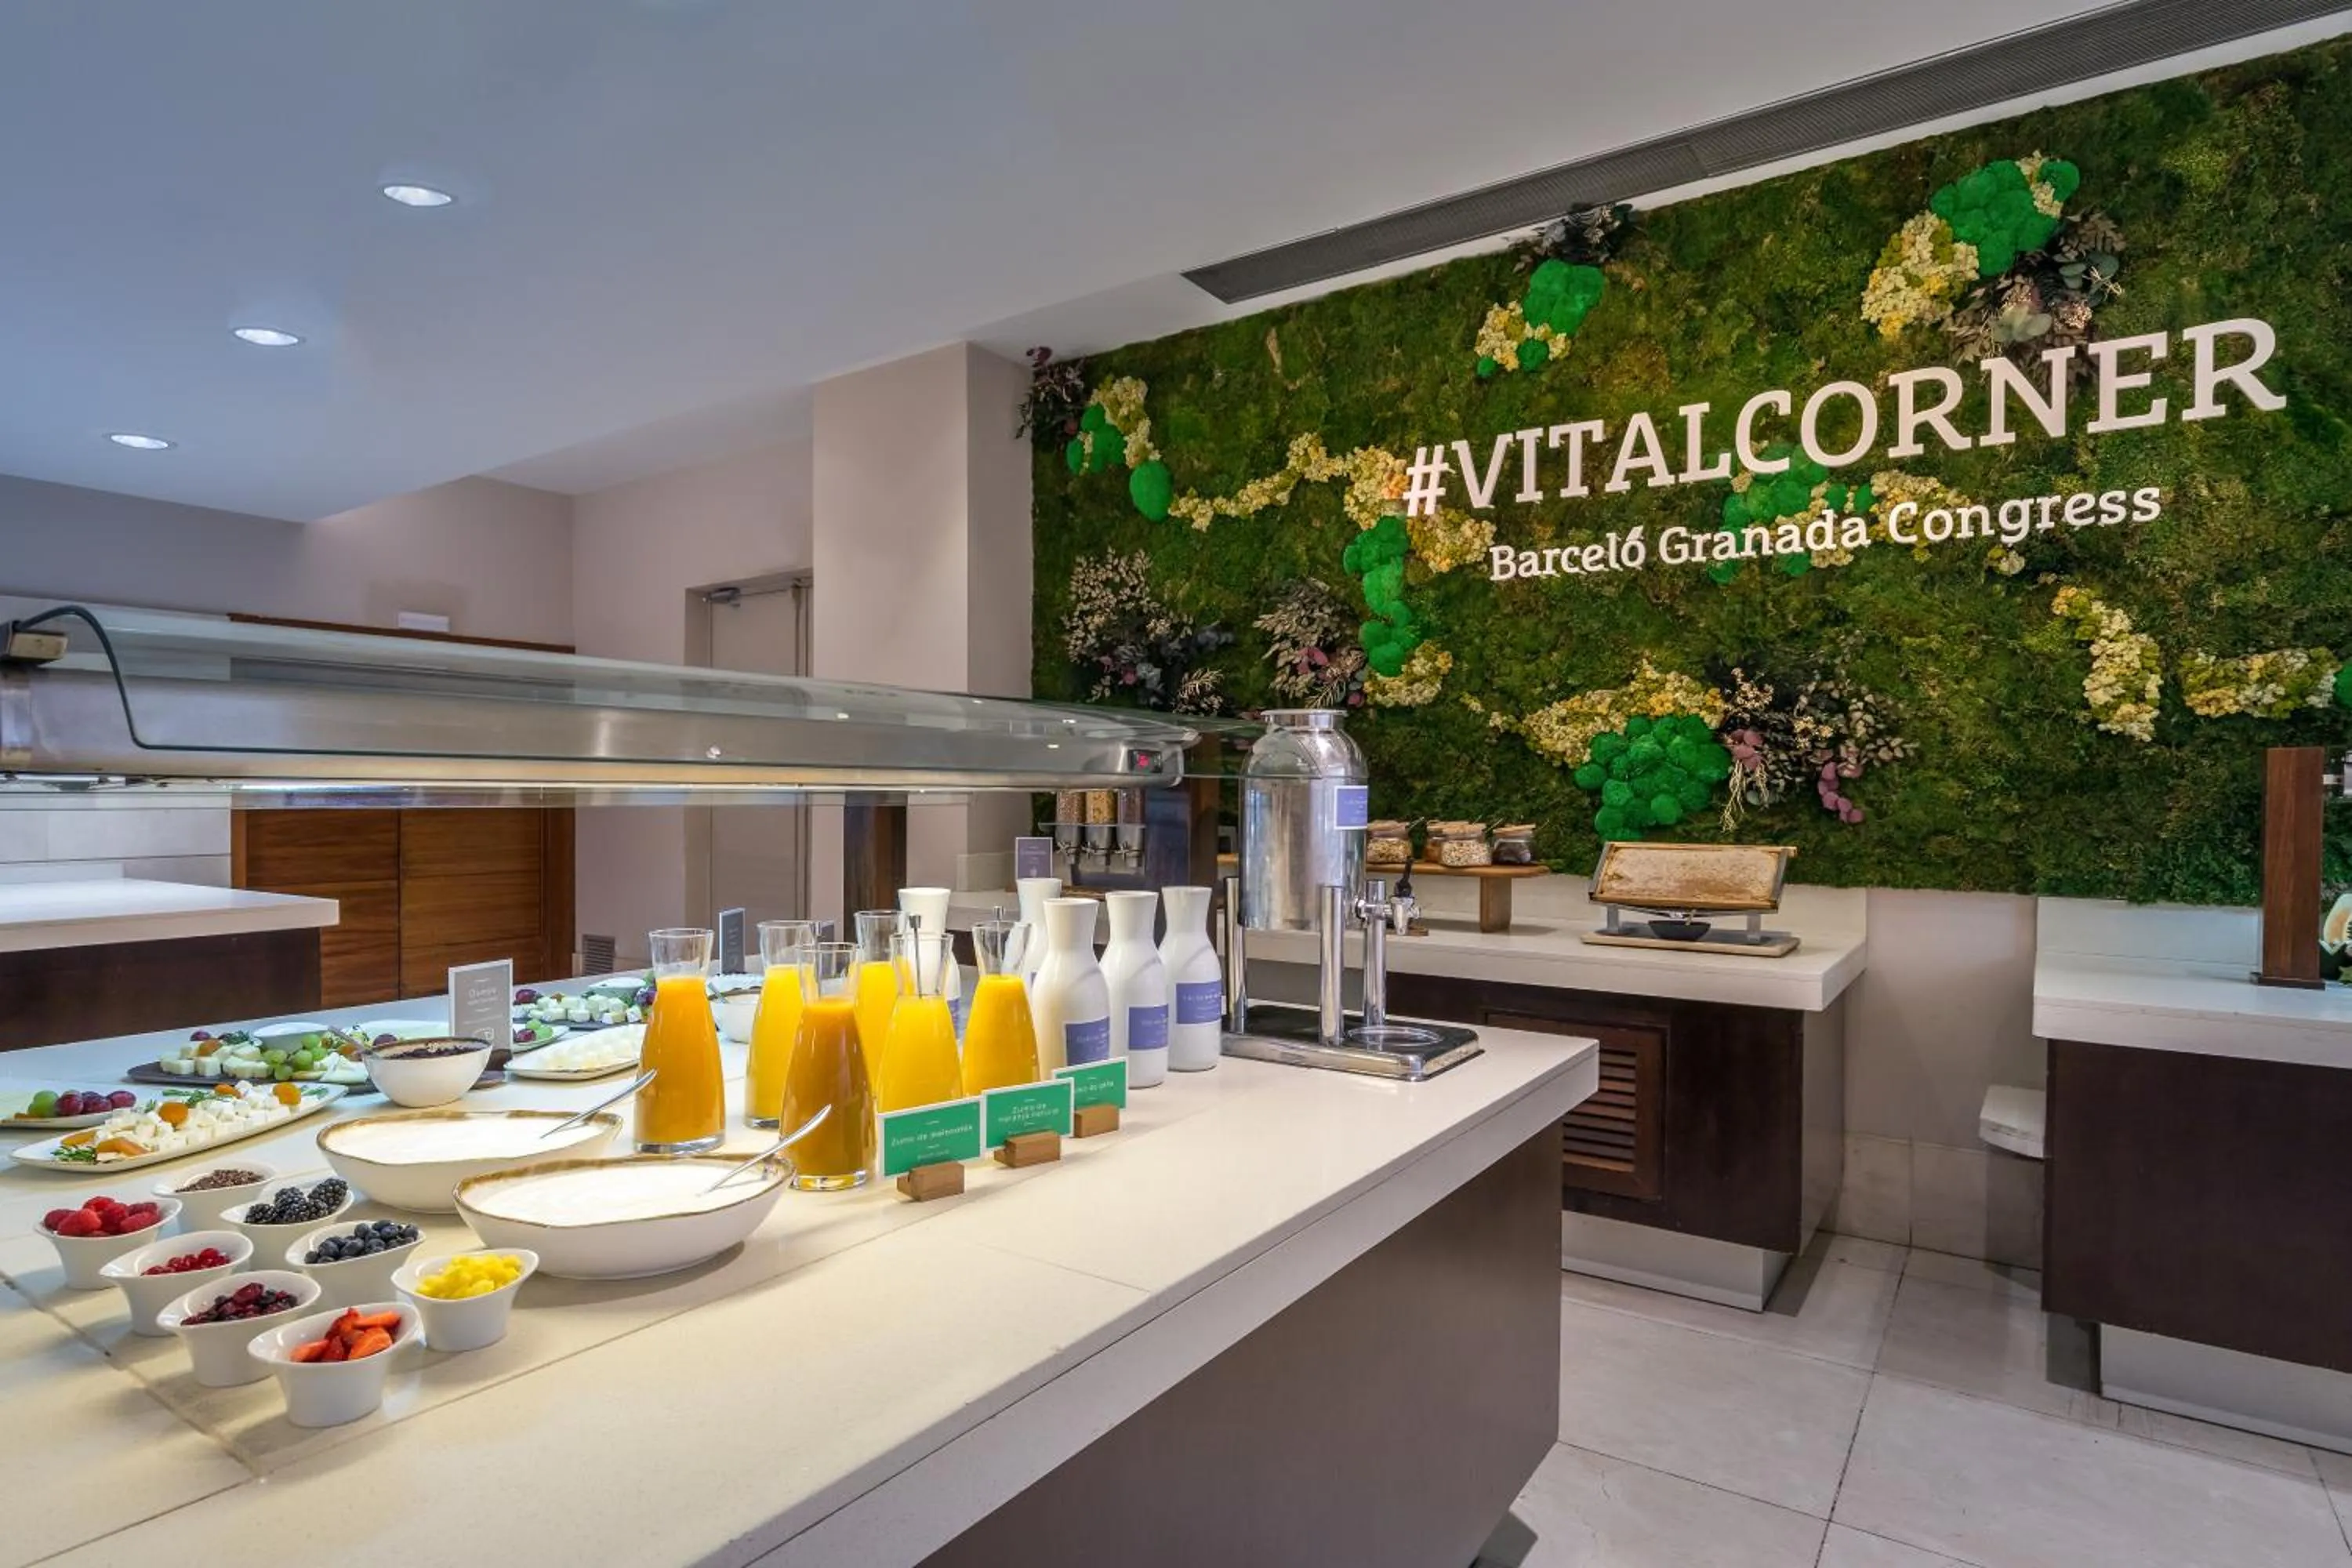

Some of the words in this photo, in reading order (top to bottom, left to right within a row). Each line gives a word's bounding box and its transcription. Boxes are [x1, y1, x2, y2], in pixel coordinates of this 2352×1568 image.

[1403, 318, 2288, 516] #VITALCORNER
[1490, 525, 1646, 582] Barceló
[1658, 508, 1871, 564] Granada
[1887, 486, 2162, 548] Congress
